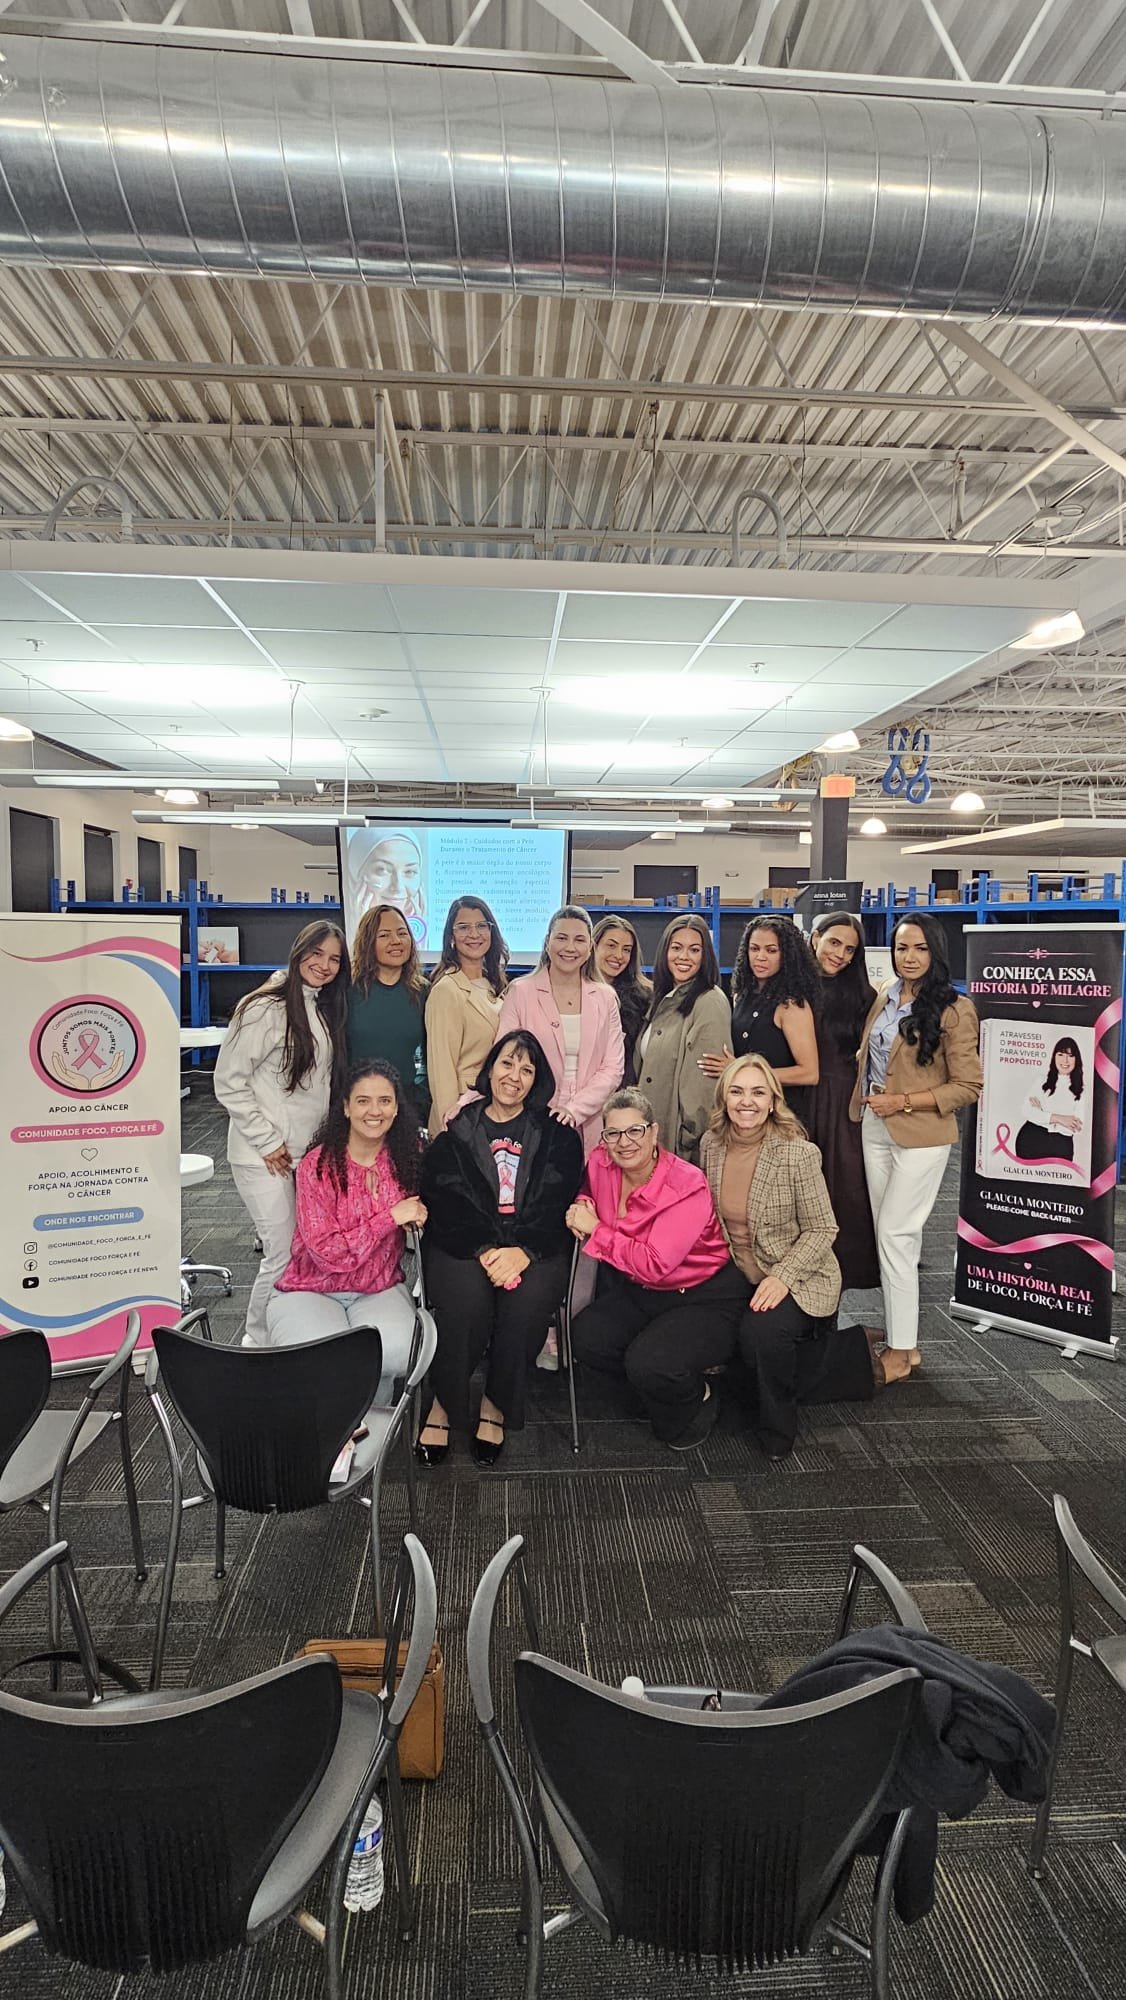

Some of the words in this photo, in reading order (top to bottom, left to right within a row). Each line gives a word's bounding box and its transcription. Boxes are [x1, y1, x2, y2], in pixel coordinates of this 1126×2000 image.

[983, 967, 1054, 984] CONHEÇA
[1058, 967, 1097, 982] ESSA
[970, 979, 1028, 995] HISTÓRIA
[1031, 983, 1049, 995] DE
[1051, 984, 1111, 997] MILAGRE
[62, 1031, 72, 1056] JUNTOS
[70, 1020, 93, 1032] SOMOS
[93, 1020, 109, 1031] MAIS
[107, 1030, 117, 1055] FORTES
[1000, 1030, 1042, 1041] ATRAVESSEI
[1007, 1040, 1046, 1050] PROCESSO
[1000, 1048, 1019, 1056] PARA
[1020, 1050, 1040, 1058] VIVER
[1041, 1051, 1047, 1059] O
[1000, 1056, 1043, 1067] PROPÓSITO
[49, 1105, 78, 1114] APOIO
[79, 1105, 92, 1113] AO
[94, 1103, 129, 1112] CÂNCER
[18, 1127, 80, 1138] COMUNIDADE
[82, 1126, 110, 1136] FOCO,
[110, 1124, 140, 1135] FORÇA
[140, 1124, 147, 1132] E
[147, 1123, 158, 1132] FÉ
[38, 1171, 69, 1180] APOIO,
[71, 1167, 133, 1178] ACOLHIMENTO
[1003, 1166, 1034, 1176] GLAUCIA
[1034, 1169, 1073, 1180] MONTEIRO
[28, 1182, 58, 1192] FORÇA
[59, 1181, 73, 1189] NA
[74, 1179, 114, 1188] JORNADA
[115, 1176, 149, 1185] CONTRA
[68, 1191, 75, 1199] O
[76, 1188, 111, 1199] CÂNCER
[980, 1190, 1024, 1206] GLAUCIA
[1026, 1198, 1084, 1216] MONTEIRO
[44, 1218, 68, 1226] ONDE
[69, 1216, 87, 1225] NOS
[88, 1212, 135, 1223] ENCONTRAR
[48, 1256, 89, 1266] COMUNIDADE
[108, 1252, 128, 1260] FORÇA
[48, 1273, 89, 1283] COMUNIDADE
[108, 1269, 128, 1277] FORÇA
[141, 1265, 158, 1273] NEWS
[967, 1264, 995, 1281] UMA
[997, 1271, 1056, 1294] HISTÓRIA
[1059, 1284, 1094, 1302] REAL
[967, 1278, 983, 1291] DE
[985, 1282, 1021, 1301] FOCO,
[1023, 1291, 1064, 1310] FORÇA
[1066, 1301, 1075, 1312] E
[1077, 1302, 1093, 1317] FÉ
